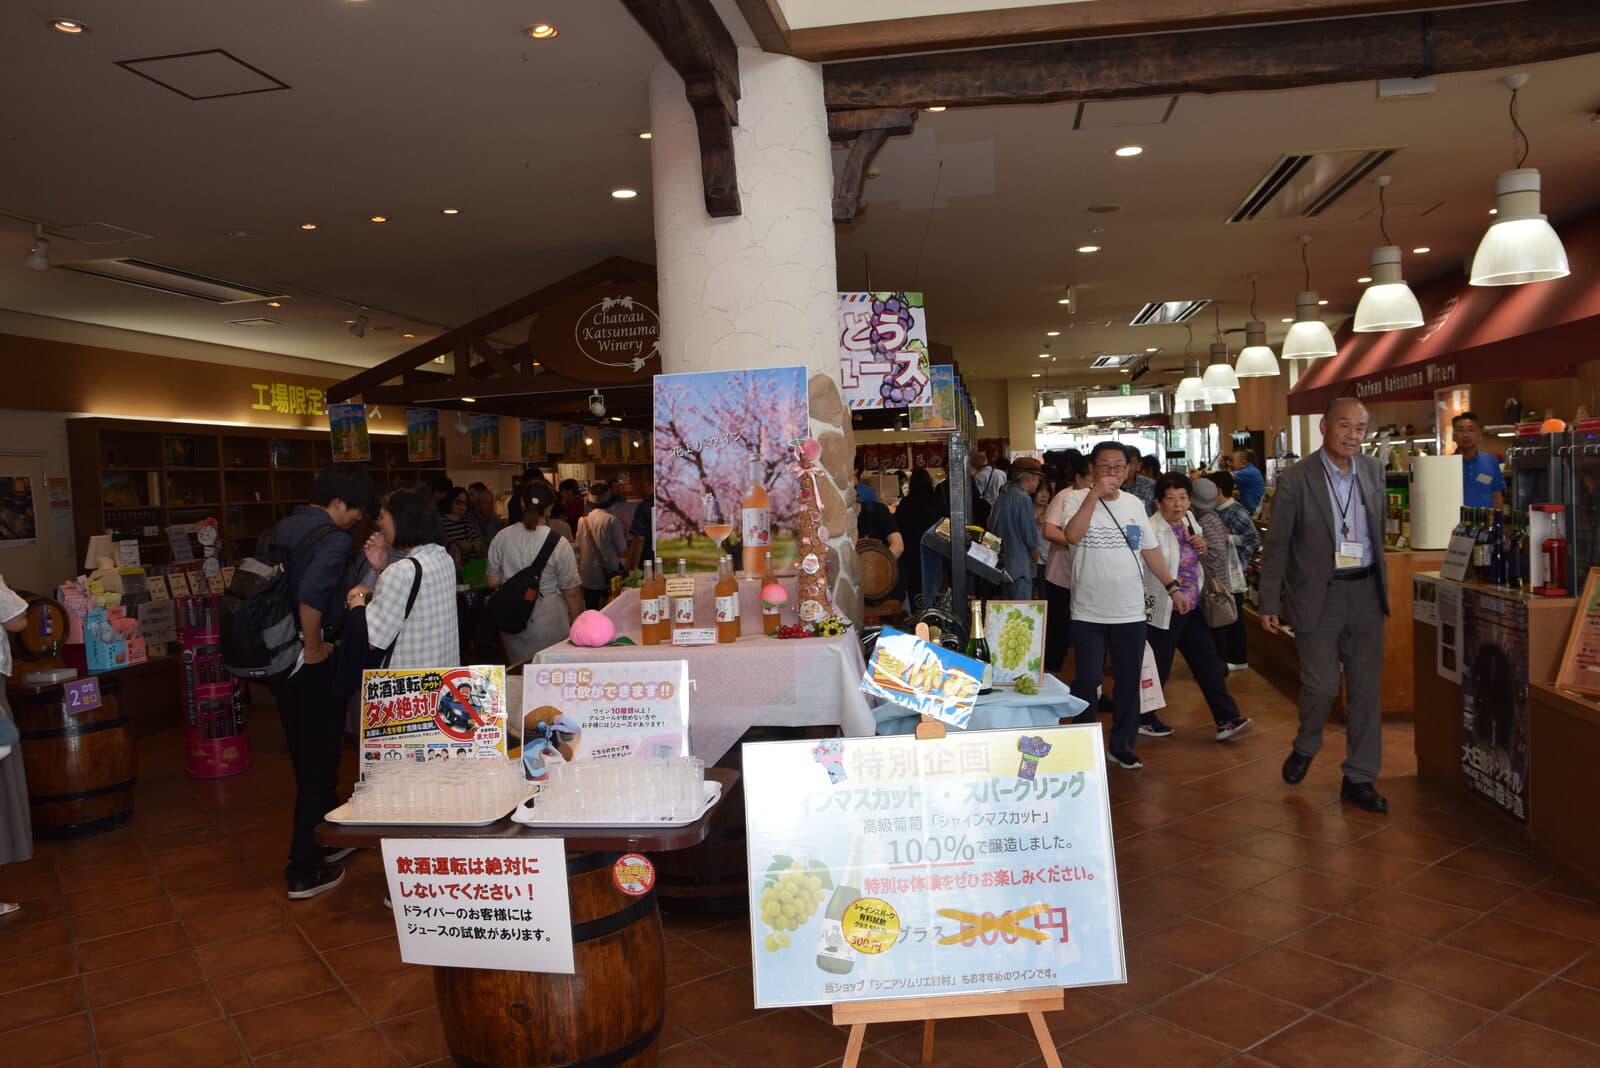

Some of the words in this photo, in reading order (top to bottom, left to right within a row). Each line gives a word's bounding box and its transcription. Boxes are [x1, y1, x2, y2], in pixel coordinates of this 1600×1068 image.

[593, 309, 644, 325] Chateau
[582, 325, 656, 340] Katsunuma
[597, 339, 643, 356] Winery
[1356, 379, 1382, 398] Chateau
[1384, 371, 1423, 393] Katsunuma
[1426, 362, 1456, 385] Winery
[537, 669, 592, 685] ご自由に
[367, 675, 421, 701] 飲酒運転
[70, 689, 81, 707] 2
[851, 741, 991, 780] 特別企画
[396, 856, 540, 876] 飲酒運転は絶対に
[863, 864, 1095, 895] 特別な体験をぜひお楽しみください。
[403, 904, 533, 922] ドライバーのお客様には
[407, 922, 552, 942] ジュースの試飲があります。
